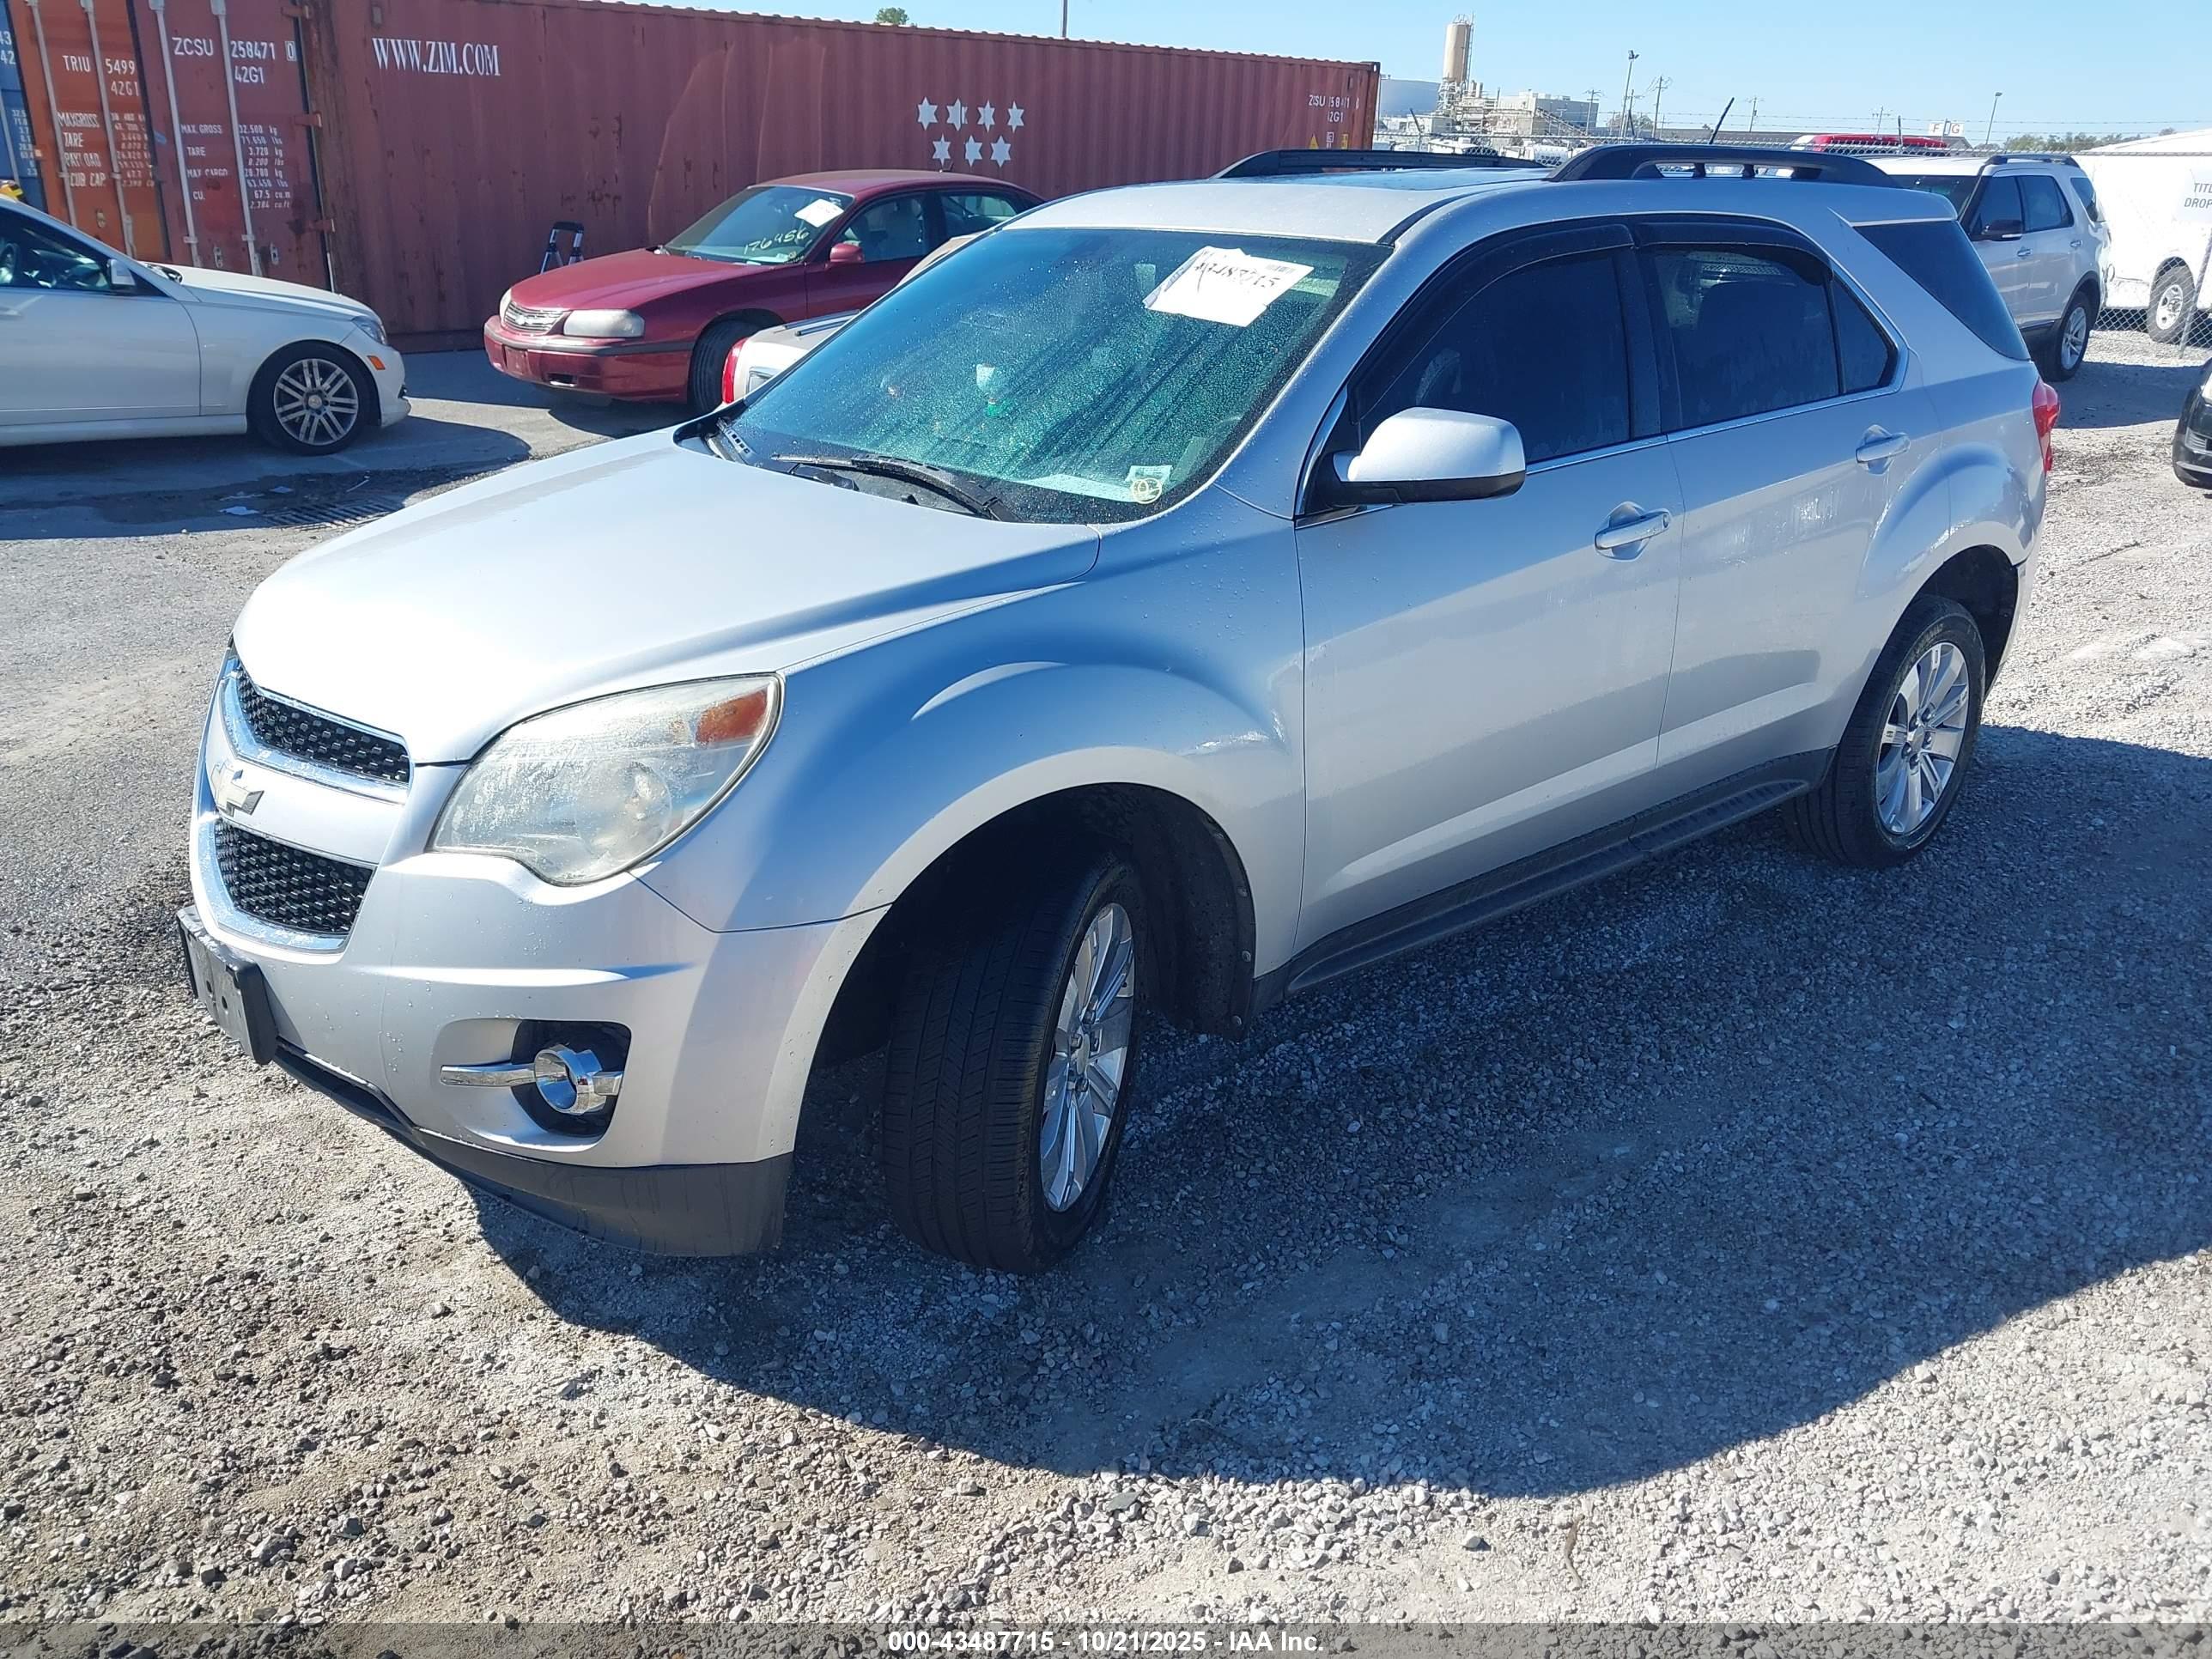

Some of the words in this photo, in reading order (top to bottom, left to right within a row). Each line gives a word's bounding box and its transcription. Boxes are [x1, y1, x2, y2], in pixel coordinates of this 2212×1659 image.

[172, 37, 214, 56] ZCSU
[230, 40, 276, 60] 258471
[372, 37, 501, 76] WWW.ZIM.COM
[62, 55, 91, 73] TRIU
[105, 58, 136, 76] 5499
[234, 65, 264, 84] 42G1
[111, 81, 139, 96] 42G1
[1327, 111, 1343, 123] 2G1
[63, 131, 84, 148] TARE
[185, 146, 206, 156] TARE
